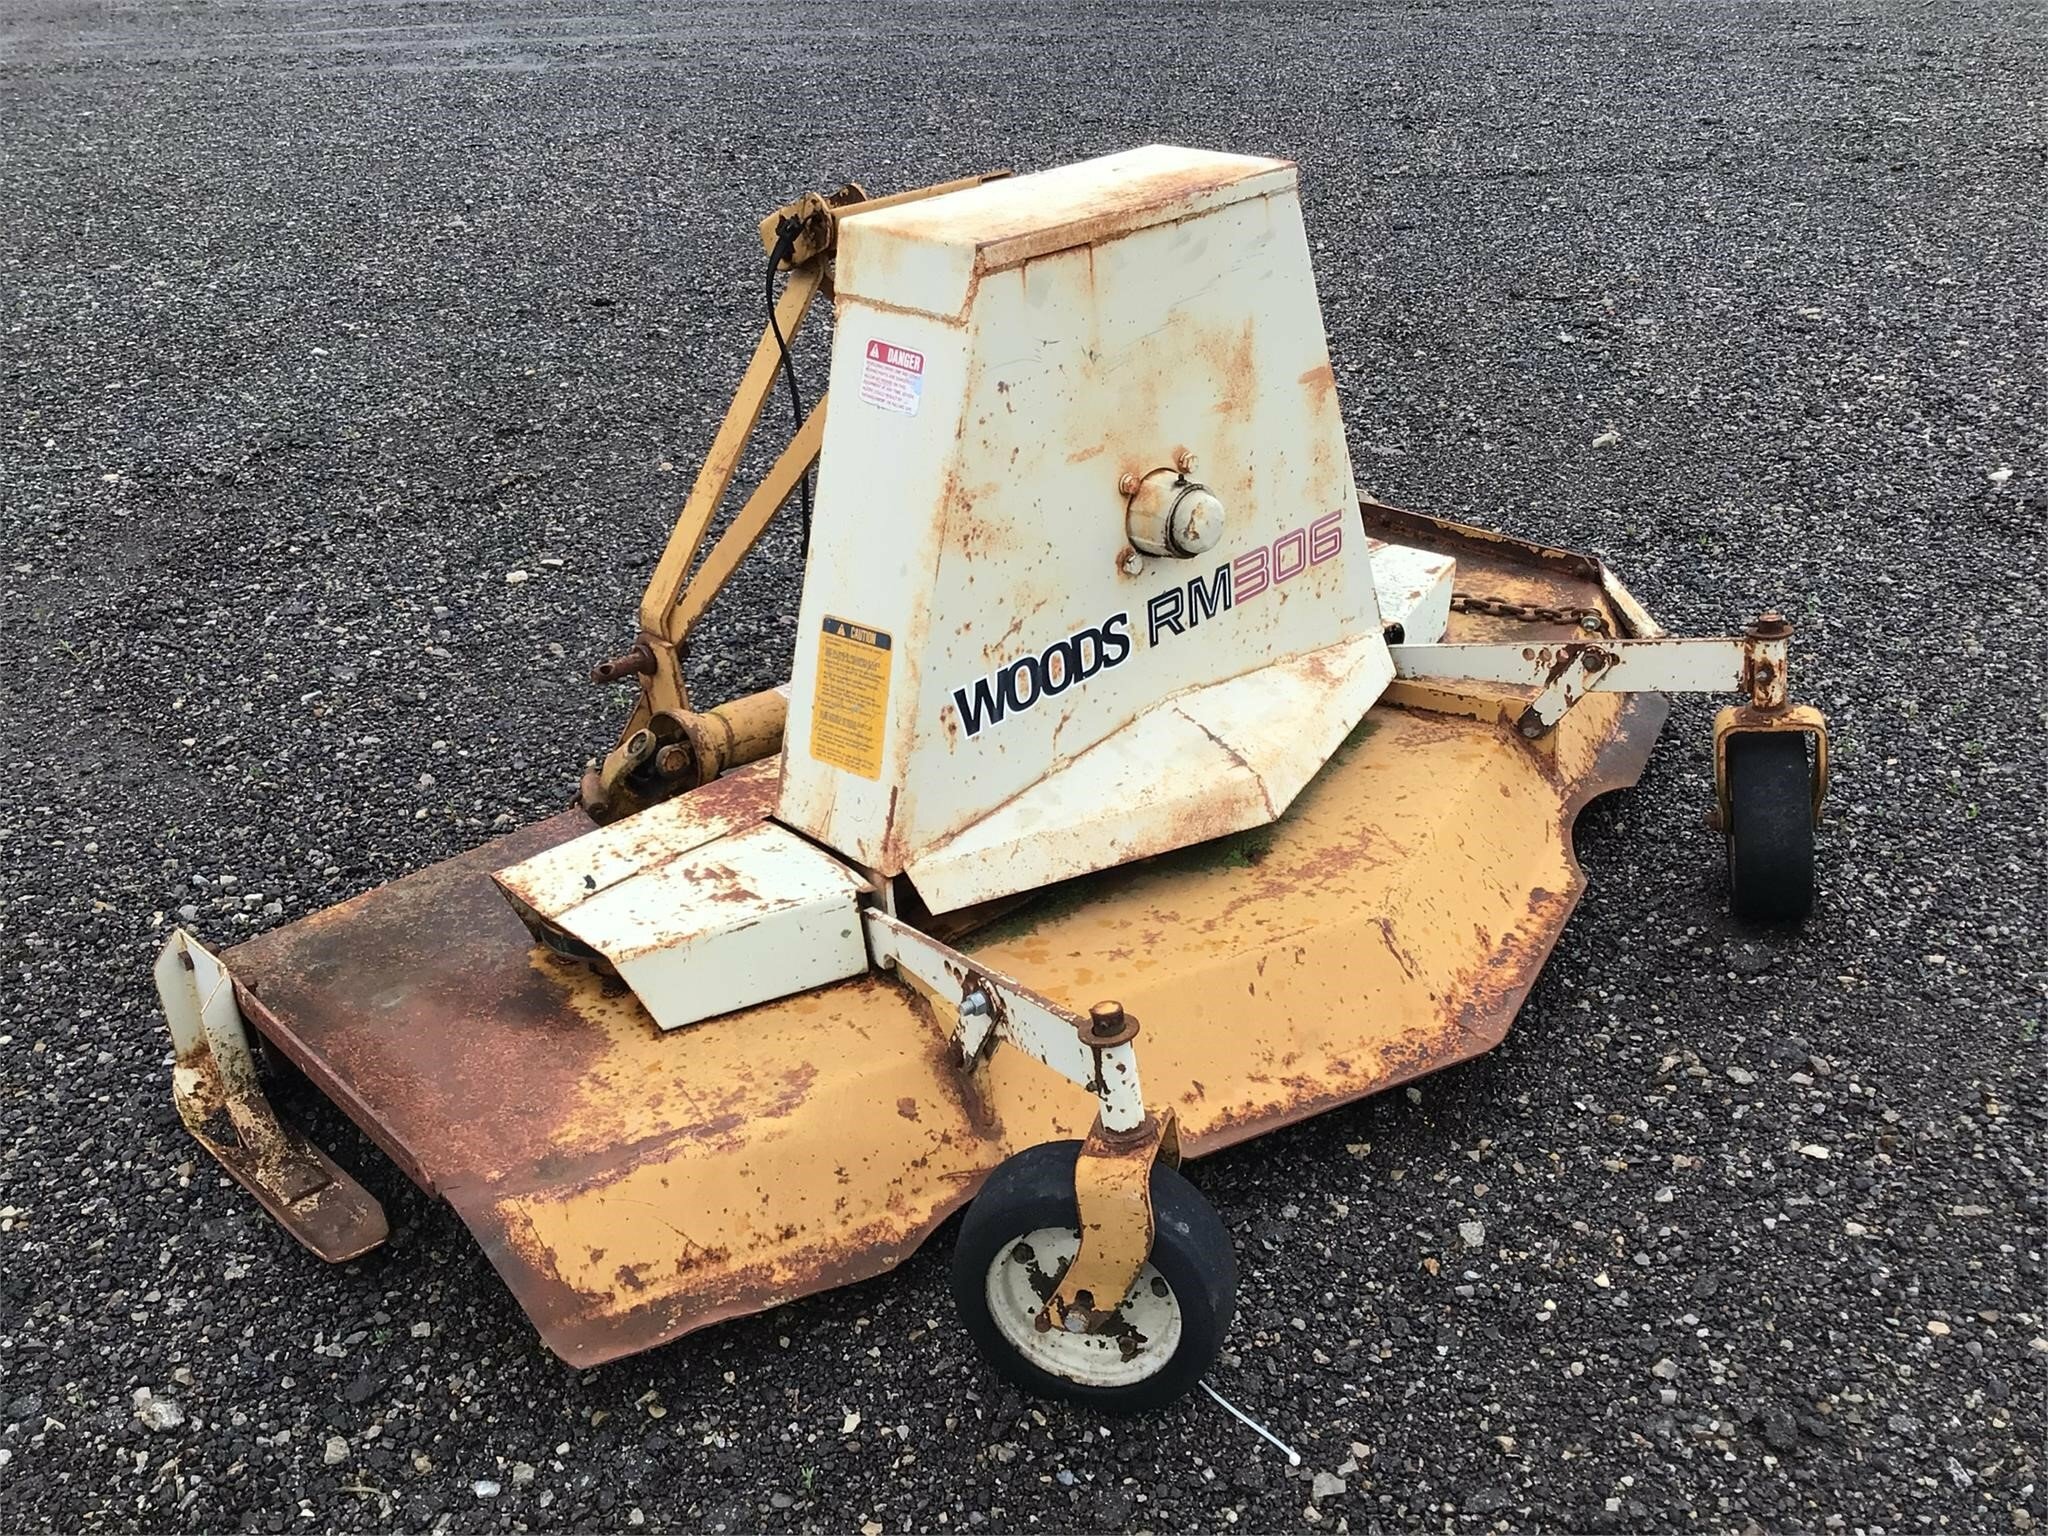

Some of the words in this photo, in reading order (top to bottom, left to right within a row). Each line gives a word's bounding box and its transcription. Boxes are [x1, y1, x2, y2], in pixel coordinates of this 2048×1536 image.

[887, 347, 922, 371] DANGER
[953, 611, 1131, 736] WOODS
[1146, 510, 1343, 648] RM306
[850, 626, 877, 645] CAUTION
